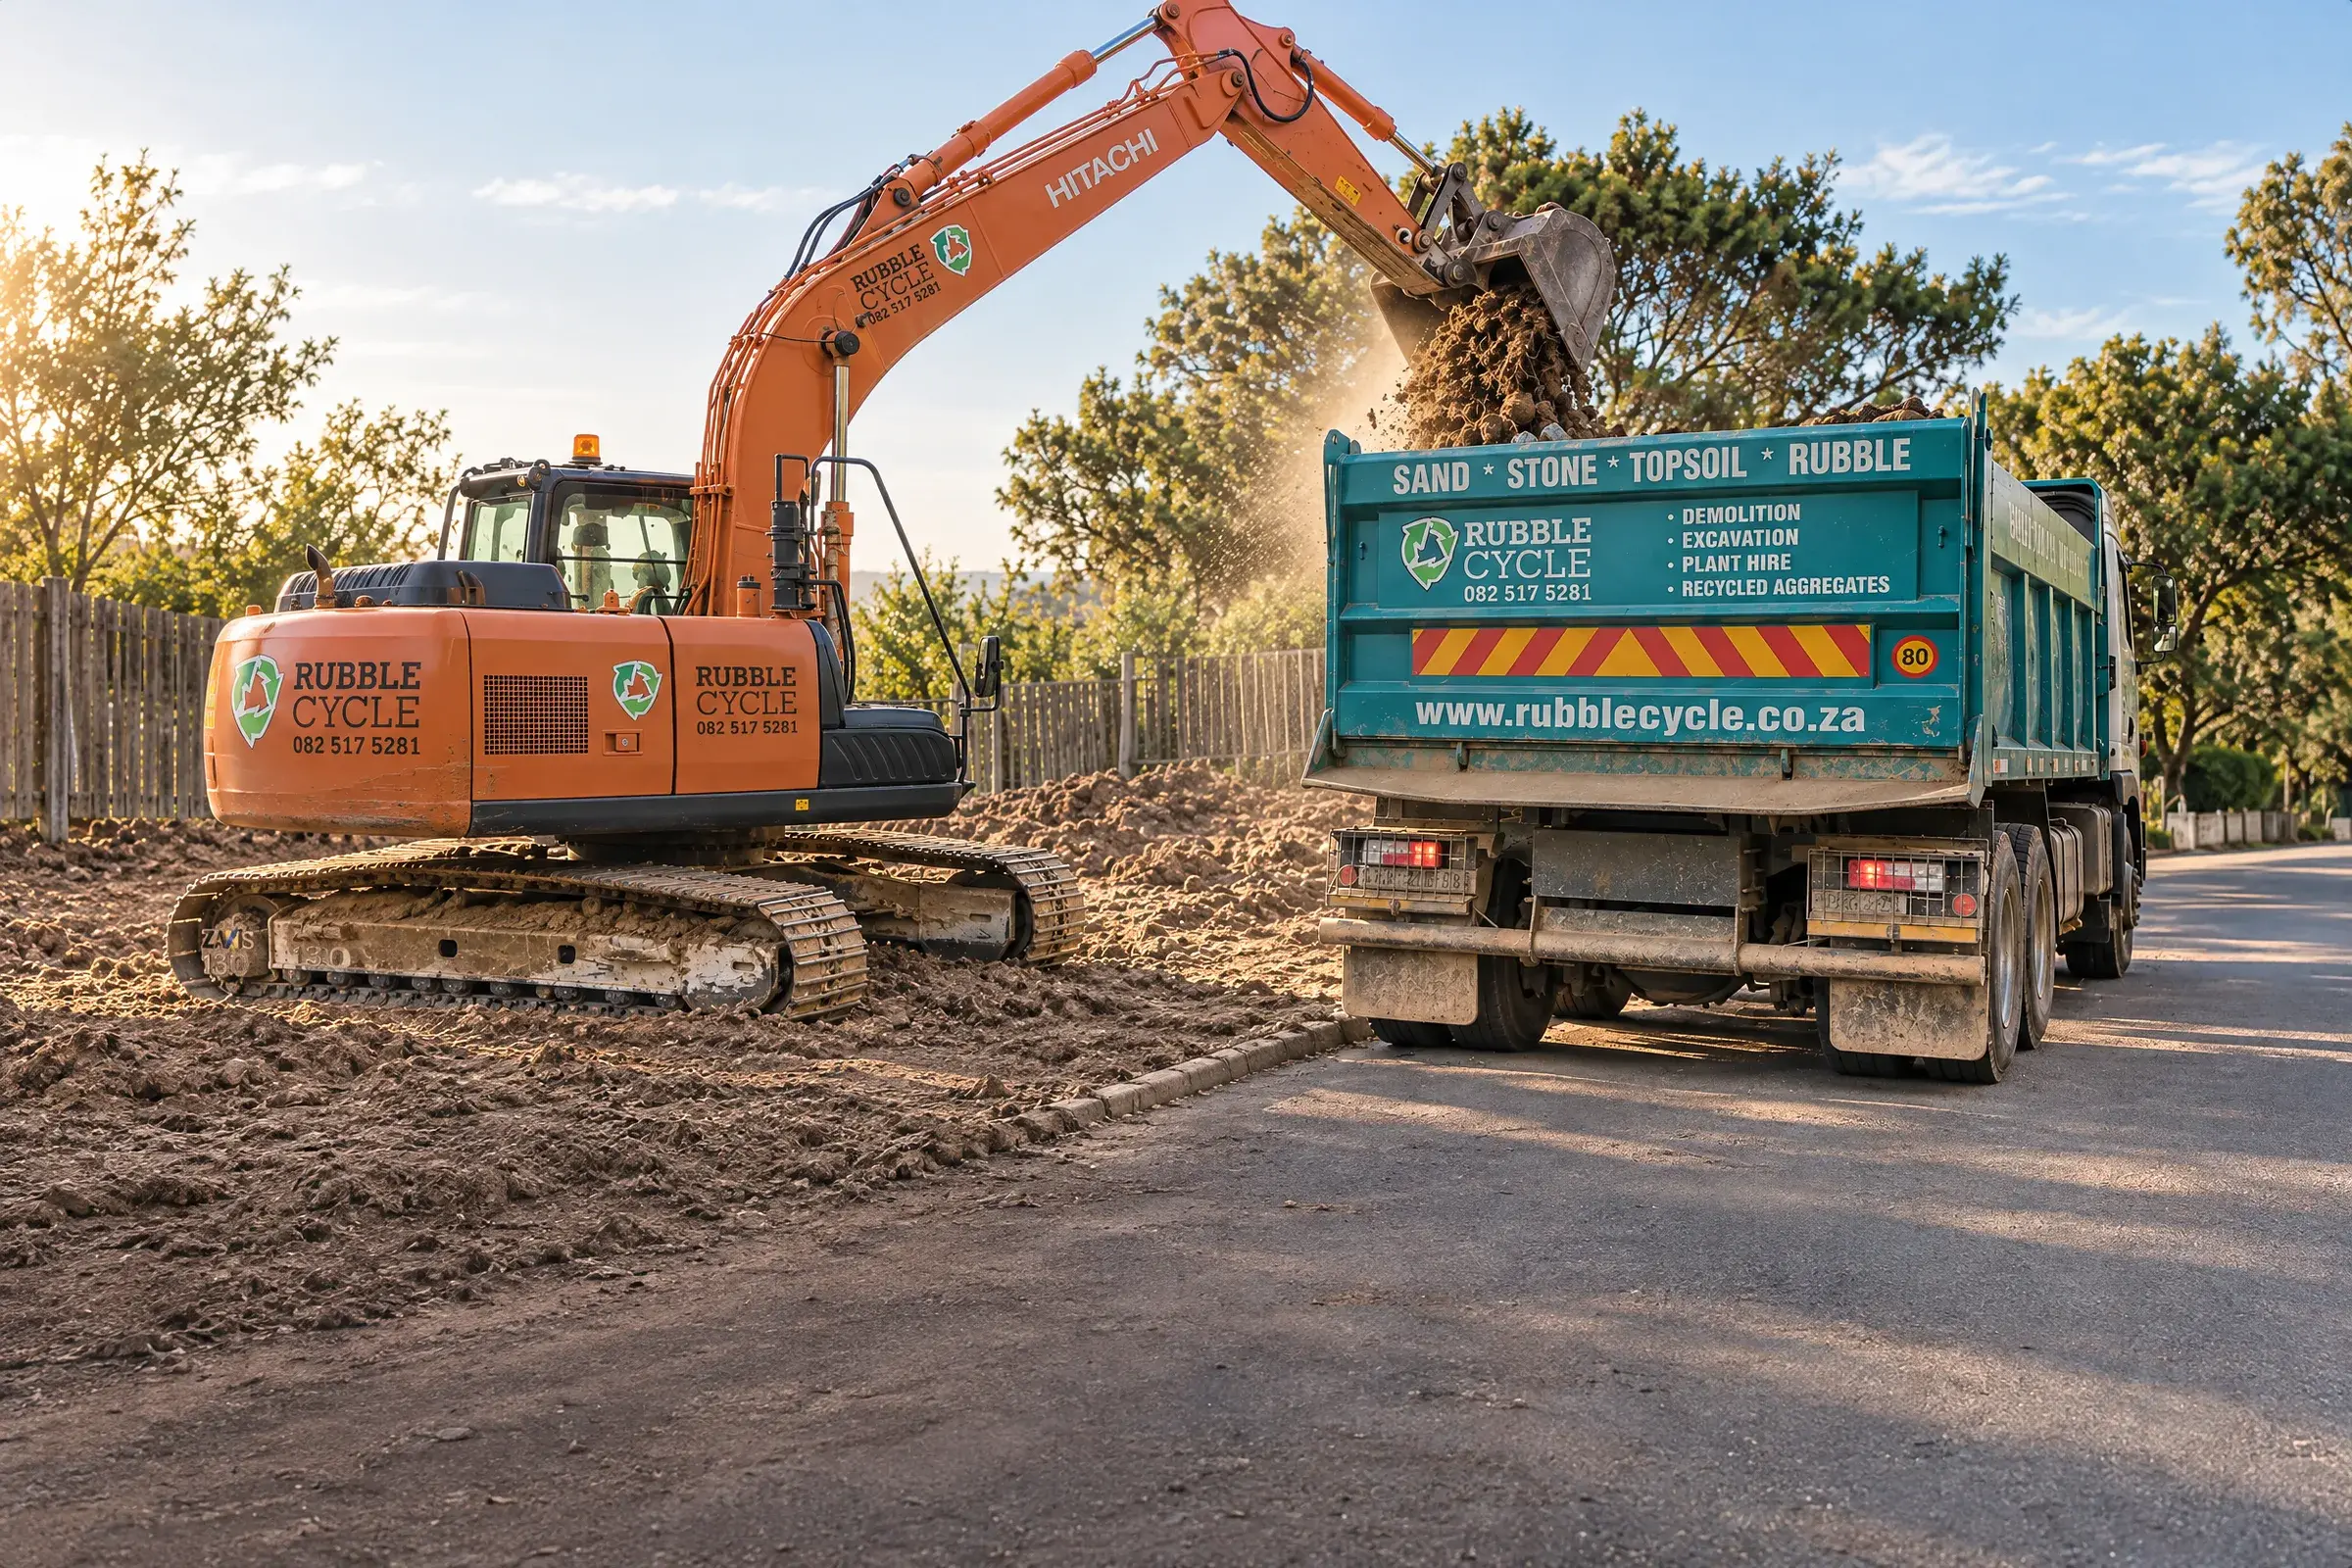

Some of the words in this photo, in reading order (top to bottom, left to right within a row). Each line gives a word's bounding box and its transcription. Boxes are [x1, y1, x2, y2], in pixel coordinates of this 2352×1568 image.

[1045, 128, 1159, 209] HITACHI
[850, 243, 925, 292] RUBBLE
[860, 261, 934, 310] CYCLE
[867, 308, 890, 324] 082
[891, 296, 911, 314] 517
[913, 281, 942, 302] 5281
[1393, 462, 1470, 495] SAND
[1507, 455, 1597, 489] STONE
[1630, 446, 1747, 483] TOPSOIL
[1789, 438, 1911, 475] RUBBLE
[1683, 504, 1800, 525] DEMOLITION
[1464, 517, 1592, 547] RUBBLE
[1683, 528, 1799, 549] EXCAVATION
[1464, 549, 1592, 579] CYCLE
[1683, 555, 1741, 572] PLANT
[1747, 554, 1791, 571] HIRE
[1464, 585, 1497, 602] 082
[1504, 585, 1539, 602] 517
[1545, 583, 1592, 601] 5281
[1683, 579, 1768, 597] RECYCLED
[1773, 575, 1890, 595] AGGREGATES
[1902, 648, 1929, 665] 80
[294, 662, 421, 690] RUBBLE
[696, 666, 796, 686] RUBBLE
[293, 695, 419, 728] CYCLE
[697, 691, 797, 715] CYCLE
[697, 721, 724, 735] 082
[730, 721, 758, 735] 517
[763, 720, 798, 734] 5281
[1415, 697, 1866, 736] www.rubblecycle.co.za
[294, 736, 324, 755] 082
[331, 736, 365, 755] 517
[371, 736, 420, 756] 5281
